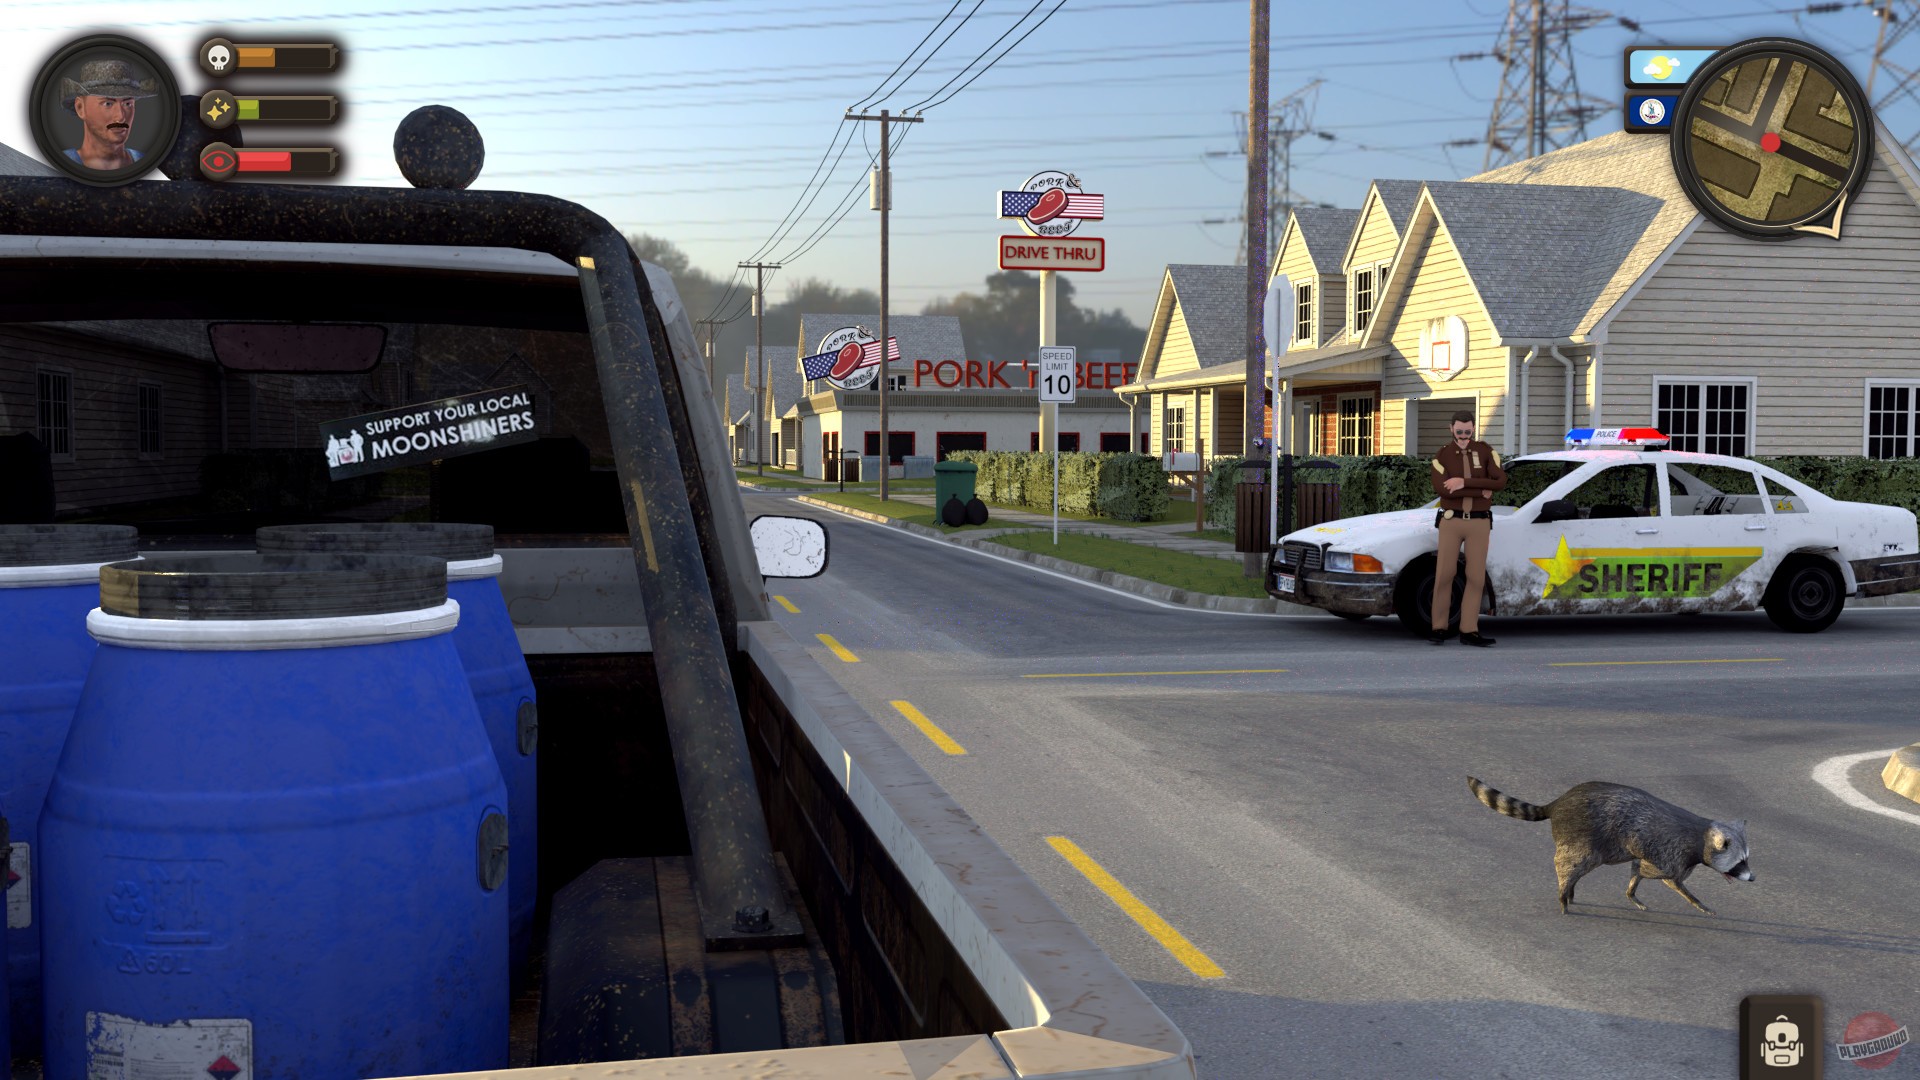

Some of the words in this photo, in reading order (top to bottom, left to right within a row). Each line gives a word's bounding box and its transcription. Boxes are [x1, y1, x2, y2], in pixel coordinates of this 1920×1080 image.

[1030, 177, 1064, 191] PORK
[1066, 173, 1082, 189] &
[1038, 218, 1074, 235] BEEF
[1005, 245, 1049, 259] DRIVE
[1053, 246, 1096, 261] THRU
[826, 331, 856, 351] PORK
[1042, 352, 1072, 361] SPEED
[914, 359, 1011, 389] PORK
[1046, 363, 1067, 371] LIMIT
[1044, 374, 1071, 395] 10
[365, 411, 431, 436] SUPPORT
[434, 402, 477, 422] YOUR
[480, 392, 531, 414] LOCAL
[371, 411, 535, 460] MOONSHINERS
[1596, 430, 1617, 438] POLICE
[1578, 563, 1723, 593] SHERIFF
